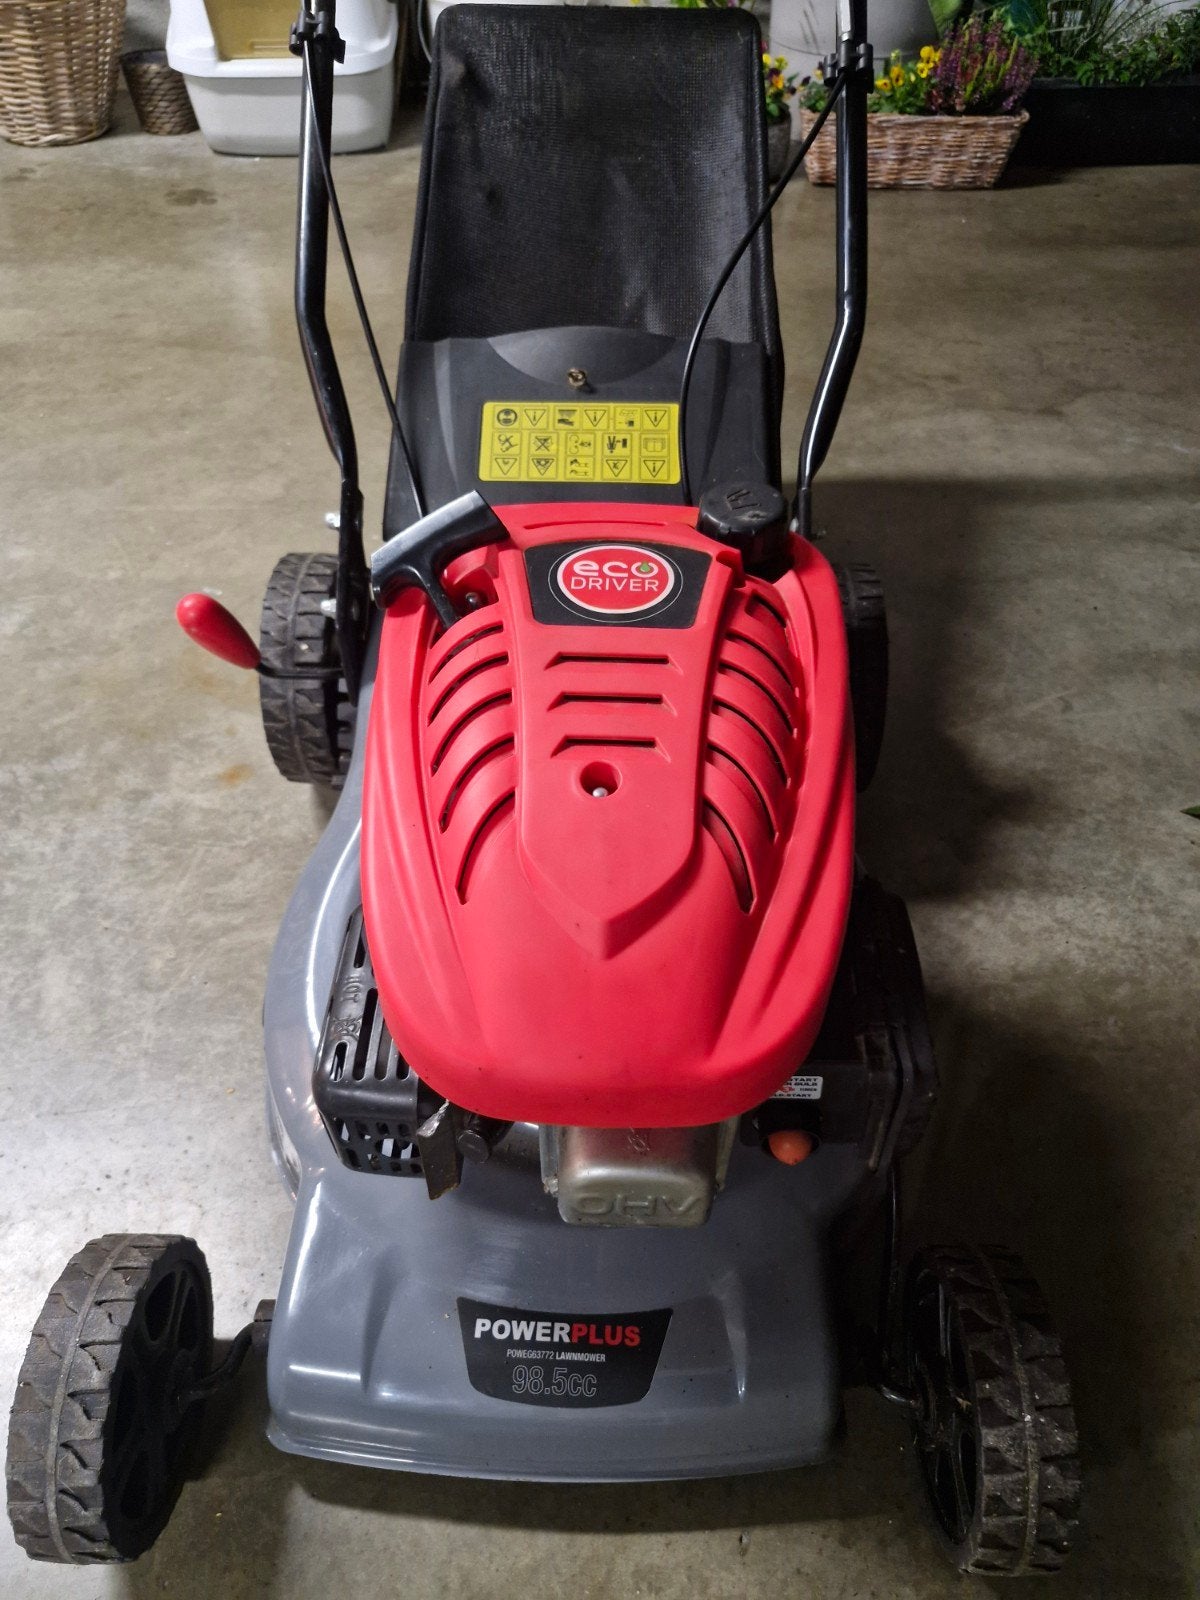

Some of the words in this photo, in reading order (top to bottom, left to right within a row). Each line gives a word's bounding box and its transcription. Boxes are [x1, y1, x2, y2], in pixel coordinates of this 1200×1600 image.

[573, 560, 659, 578] eco
[570, 576, 659, 592] DRIVER
[474, 1318, 641, 1347] POWERPLUS
[555, 1351, 606, 1363] LAWNMOWER
